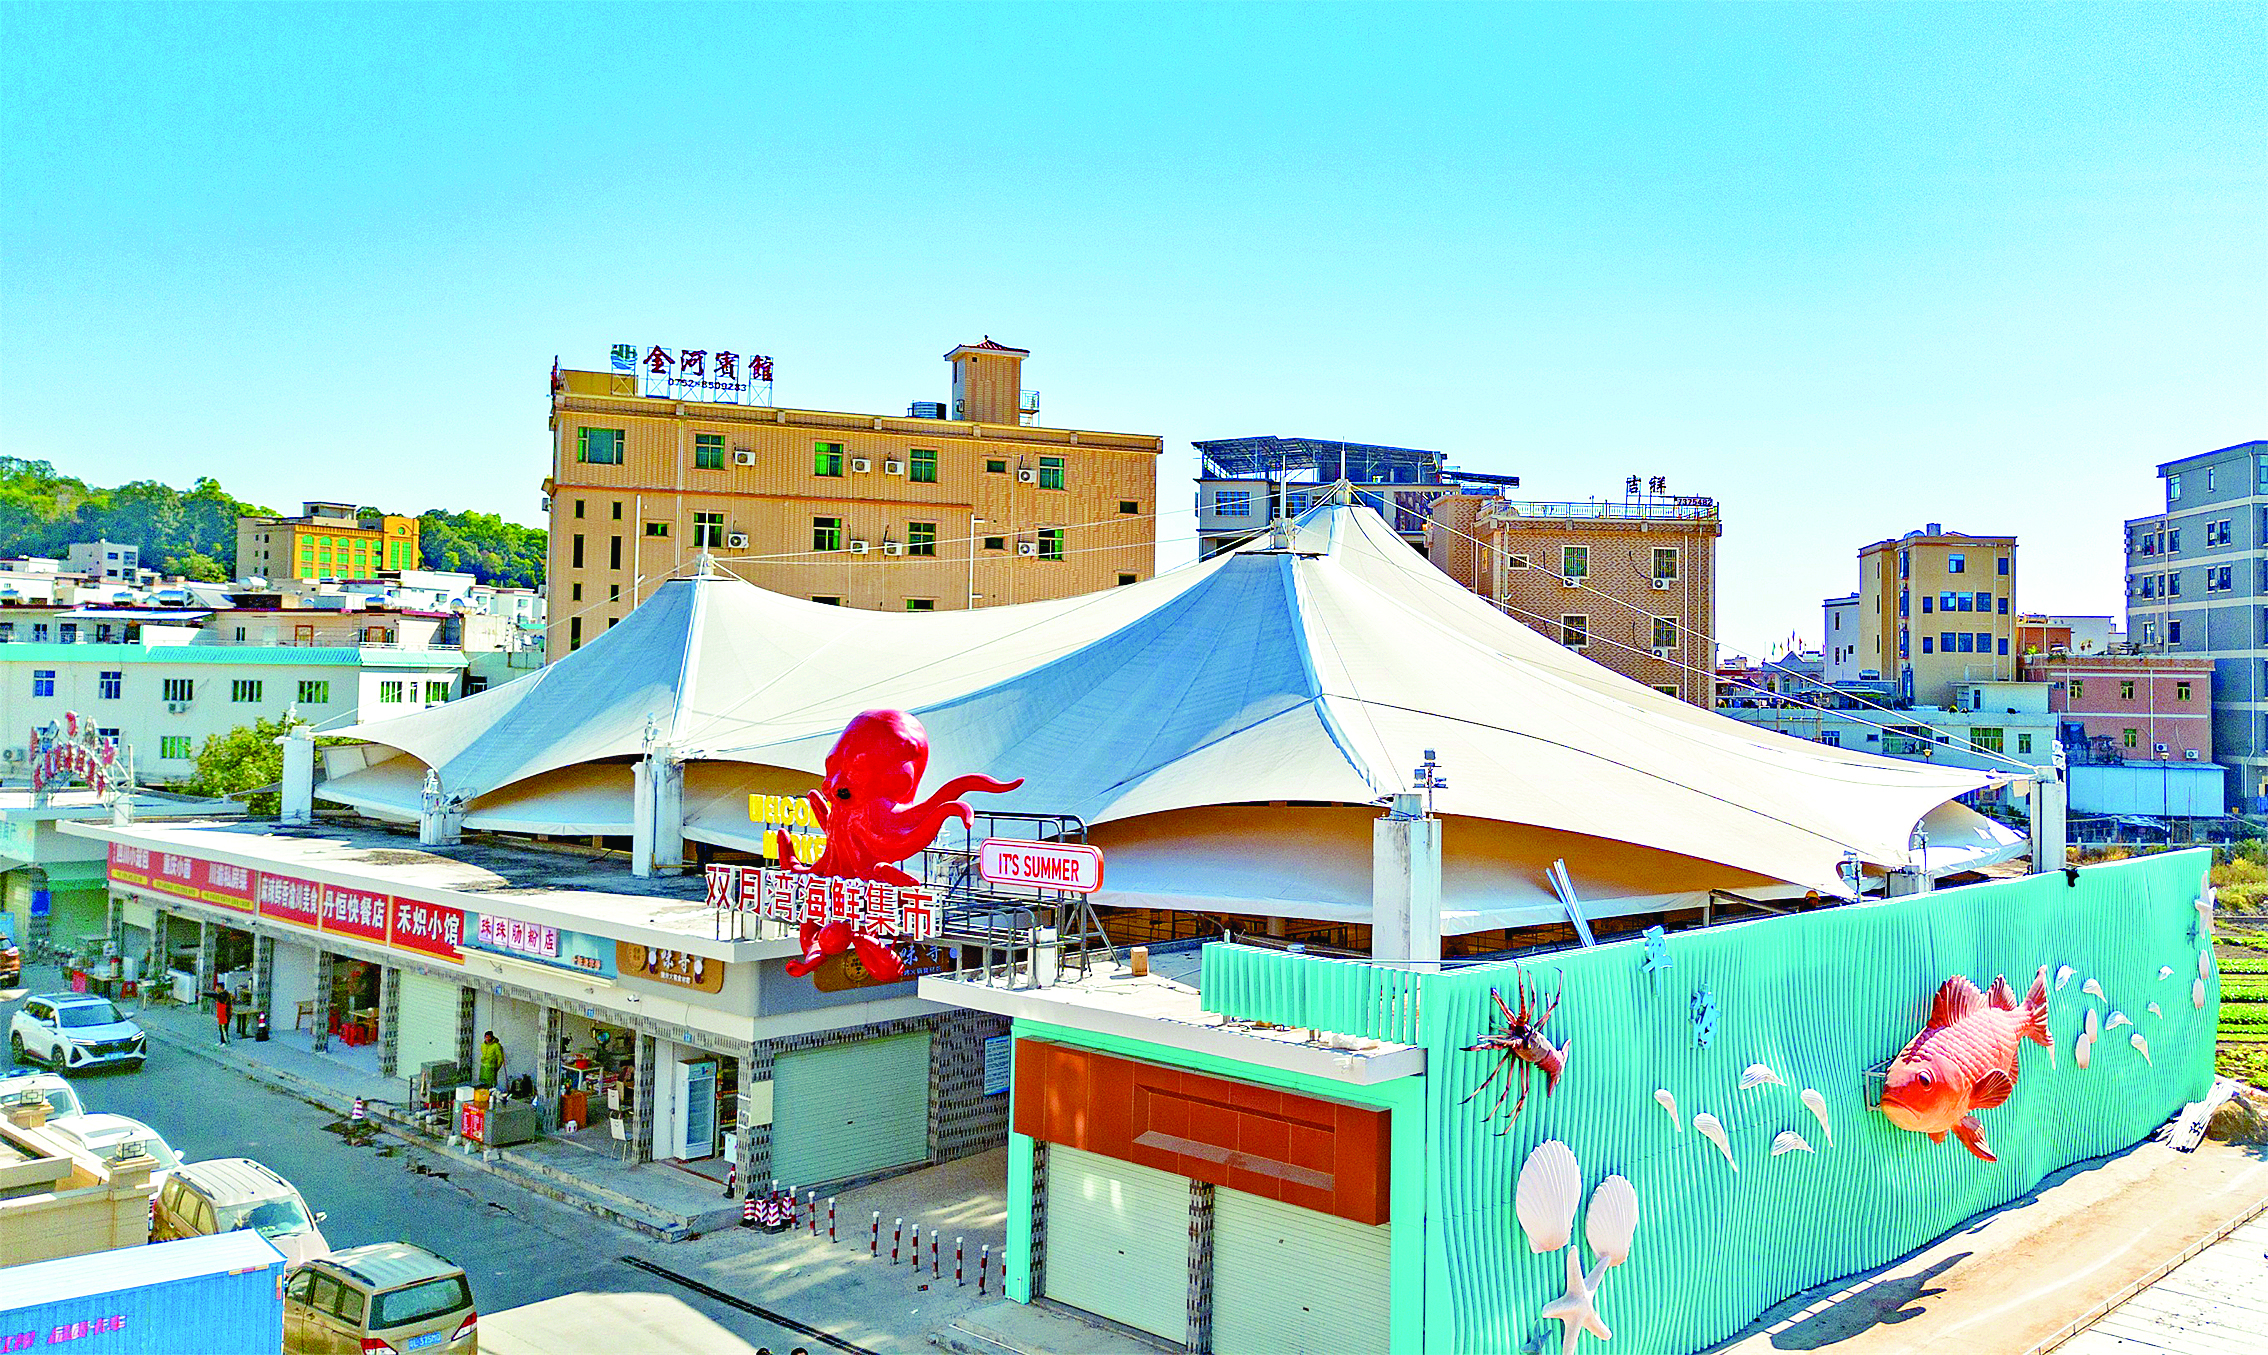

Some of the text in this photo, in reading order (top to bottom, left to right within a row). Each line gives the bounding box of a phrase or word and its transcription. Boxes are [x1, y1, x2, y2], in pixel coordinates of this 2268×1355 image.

[1626, 475, 1667, 495] 吉祥
[748, 793, 832, 828] WELCO
[999, 852, 1079, 882] IT'S SUMMER
[323, 890, 386, 929] 丹恒快餐店
[705, 864, 942, 941] 双月湾海鲜集市
[397, 904, 460, 946] 禾炽小馆
[481, 918, 554, 950] 珠珠肠粉店
